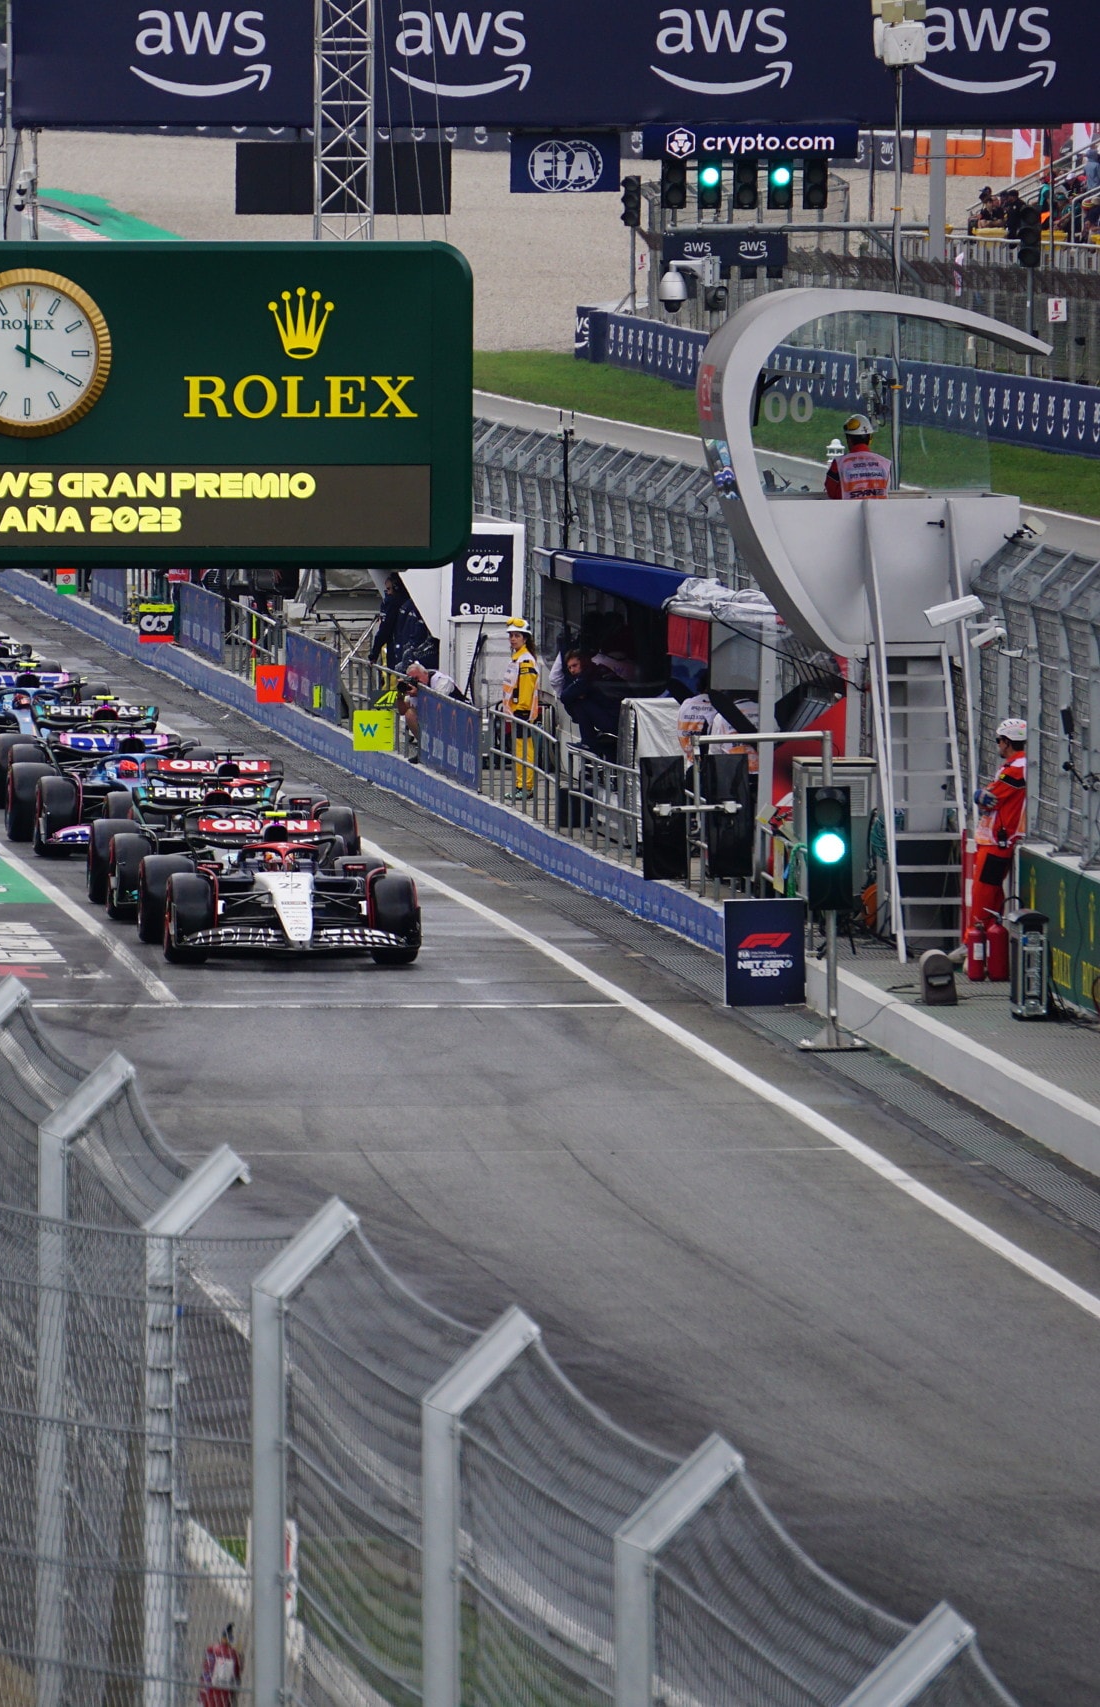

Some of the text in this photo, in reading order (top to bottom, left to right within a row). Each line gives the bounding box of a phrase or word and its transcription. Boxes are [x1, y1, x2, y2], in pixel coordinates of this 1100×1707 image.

[135, 9, 267, 57] aws
[395, 9, 527, 57] aws
[656, 7, 788, 54] aws
[922, 7, 1052, 53] aws
[703, 133, 835, 154] crypto.com
[683, 241, 711, 253] aws
[739, 240, 767, 252] aws
[0, 319, 55, 331] ROLEX
[183, 374, 418, 419] ROLEX
[57, 471, 166, 499] GRAN
[171, 471, 316, 499] PREMIO
[90, 506, 182, 533] 2023
[473, 604, 504, 615] Rapid
[737, 960, 794, 969] NET ZERO
[750, 968, 780, 977] 2030
